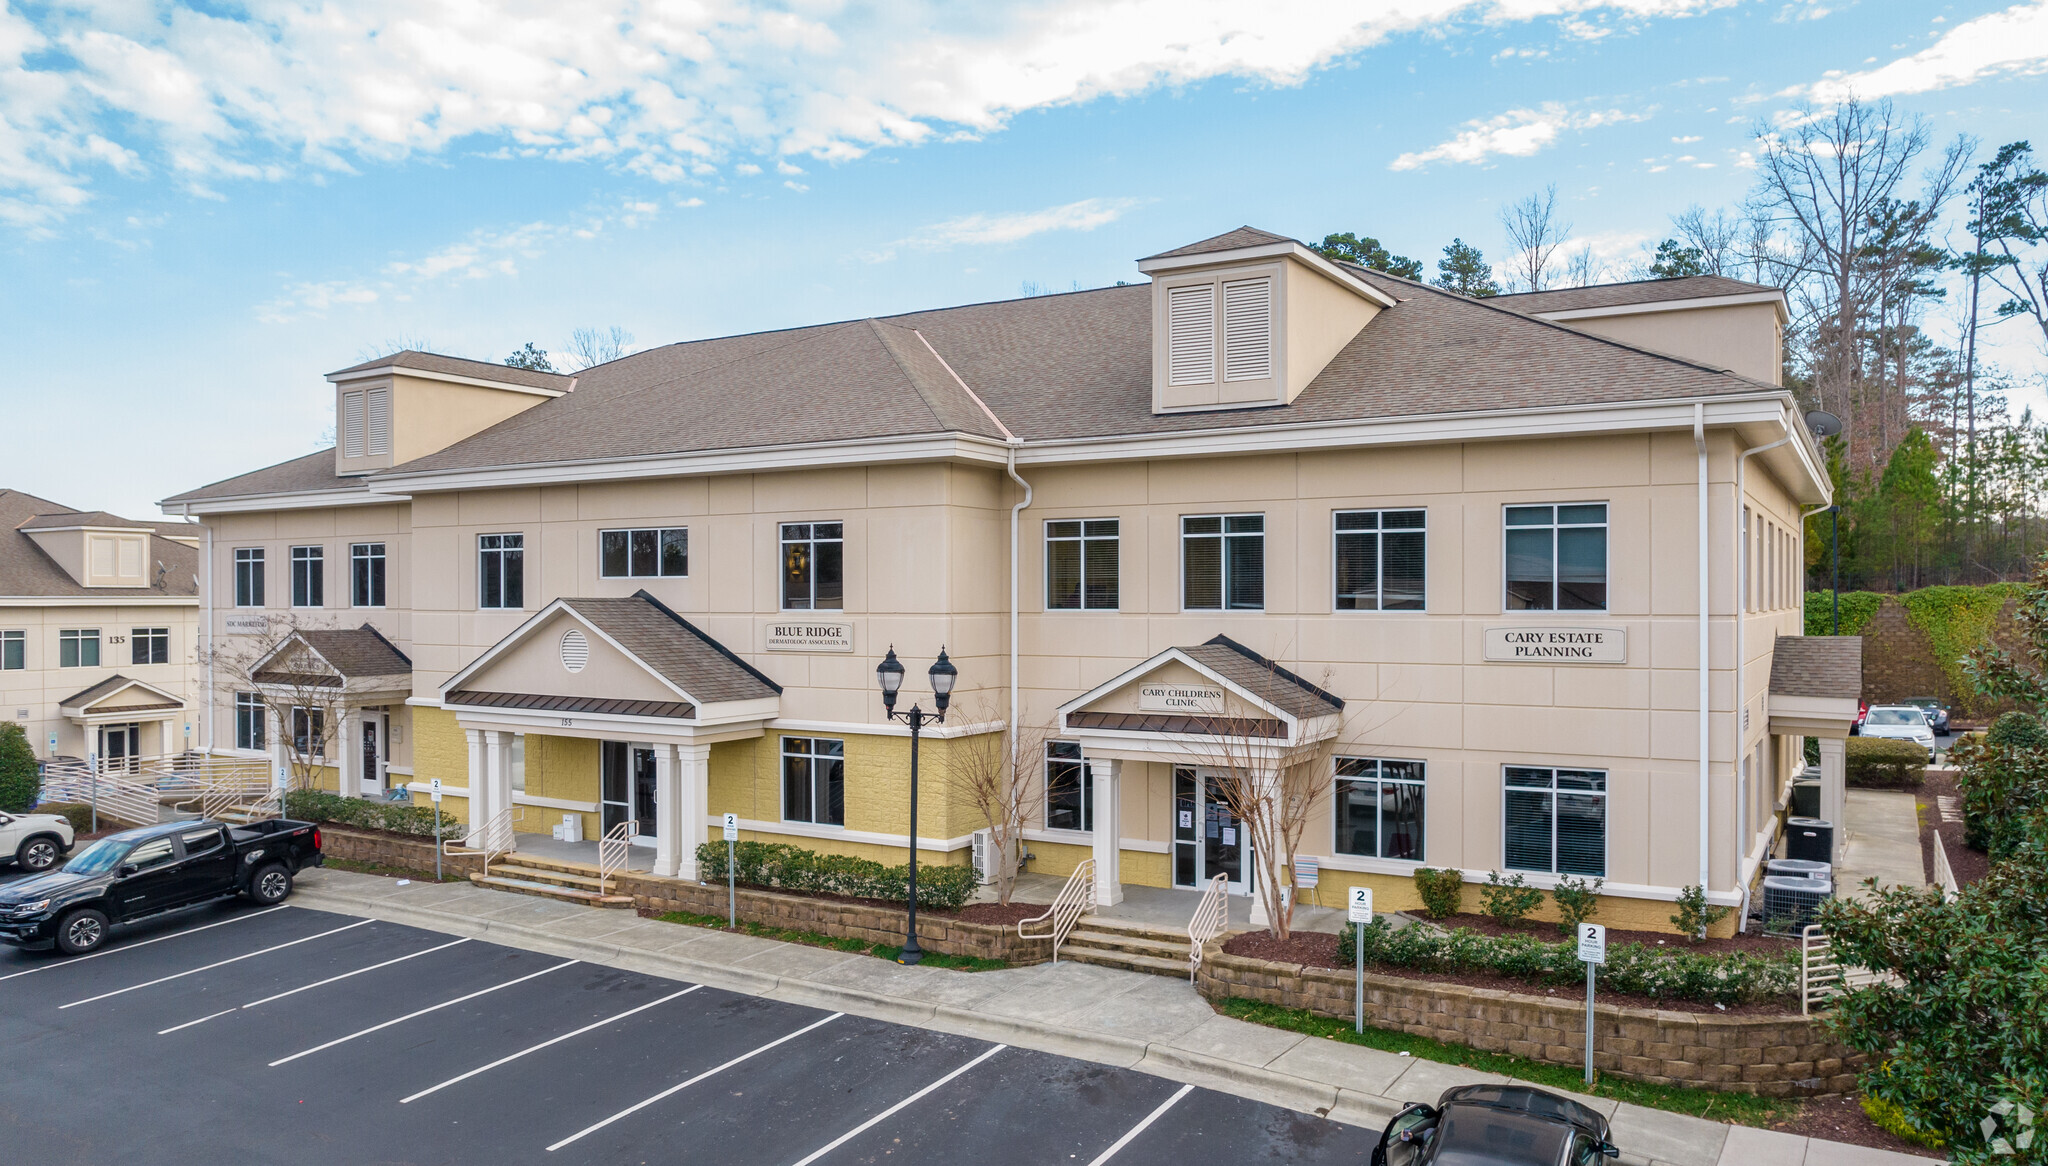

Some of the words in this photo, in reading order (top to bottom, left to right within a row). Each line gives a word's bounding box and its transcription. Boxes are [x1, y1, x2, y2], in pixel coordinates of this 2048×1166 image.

[775, 626, 803, 636] BLUE
[806, 626, 842, 637] RIDGE
[109, 636, 125, 644] 135
[1504, 632, 1545, 643] CARY
[1549, 632, 1604, 643] ESTATE
[1515, 646, 1593, 658] PLANNING
[1142, 688, 1166, 697] CARY
[1168, 689, 1221, 698] CHILDRENS
[1165, 698, 1197, 707] CLINIC
[561, 718, 573, 726] 155
[728, 815, 734, 824] 2
[1357, 890, 1365, 901] 2
[1587, 927, 1597, 939] 2
